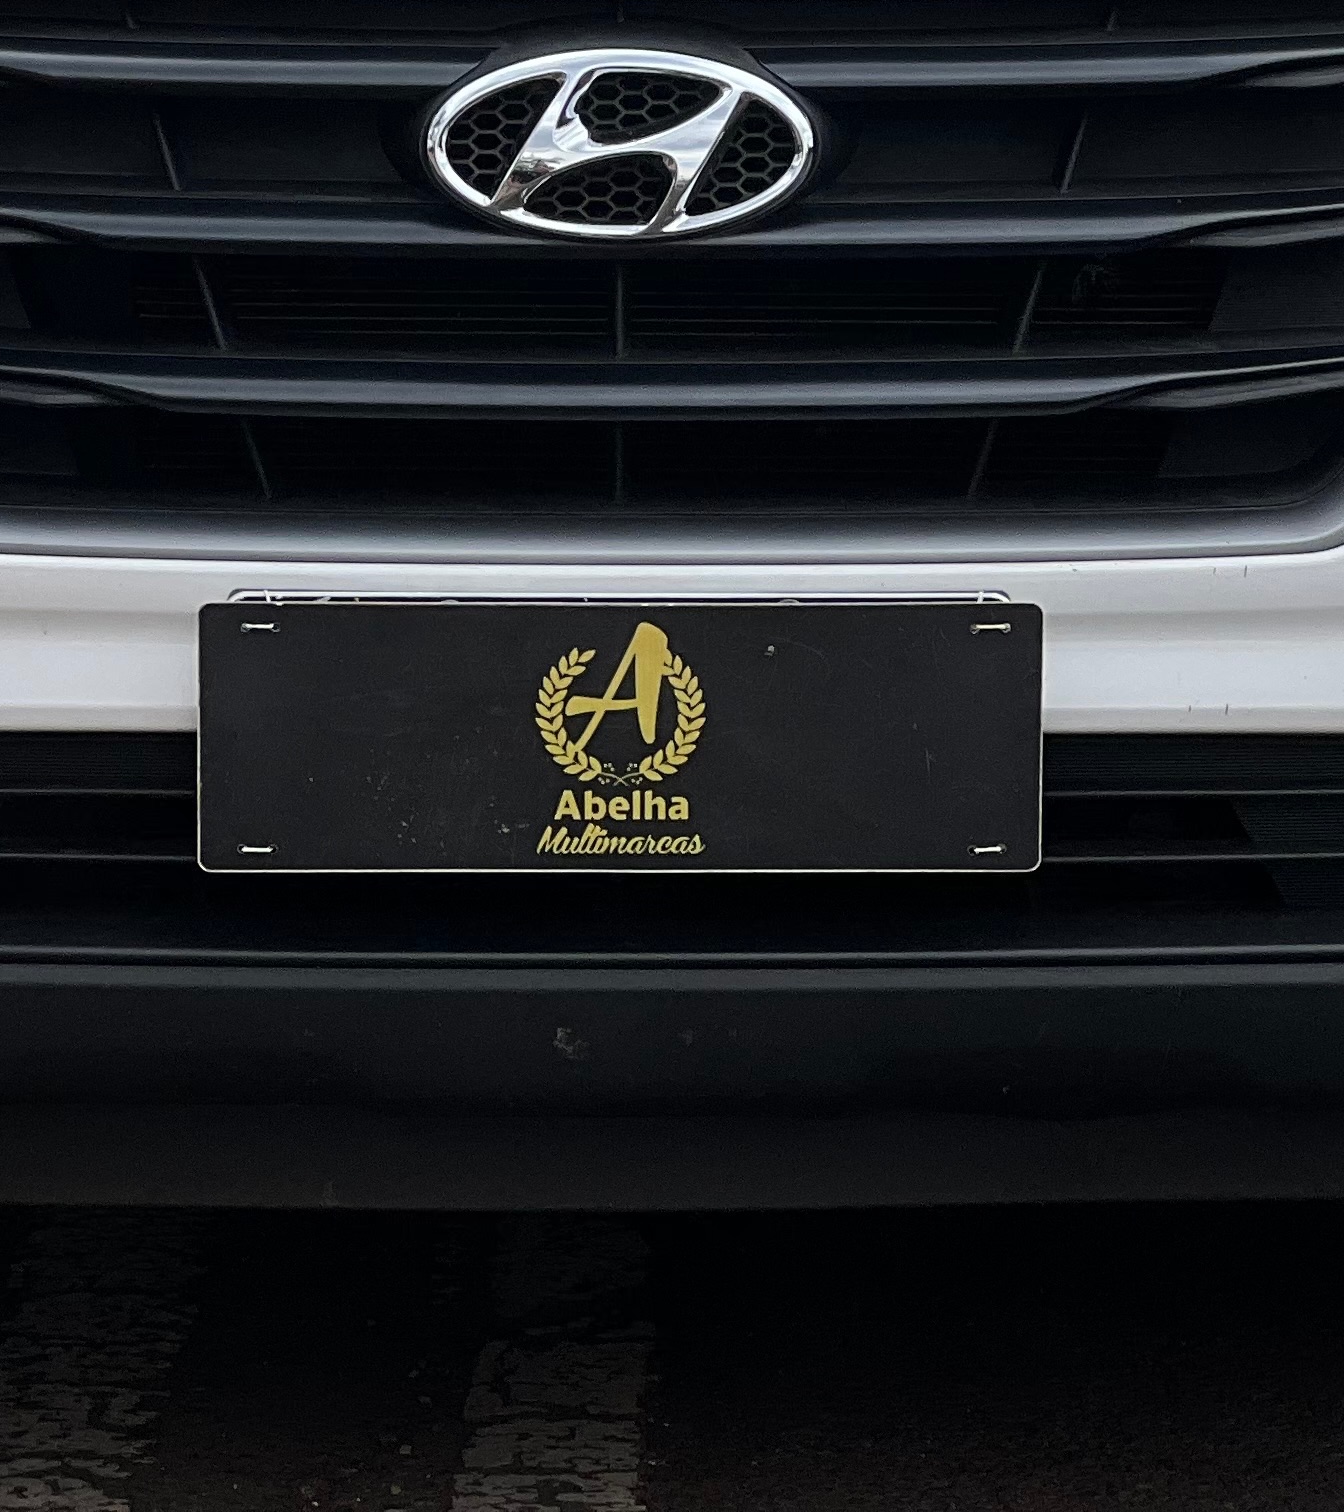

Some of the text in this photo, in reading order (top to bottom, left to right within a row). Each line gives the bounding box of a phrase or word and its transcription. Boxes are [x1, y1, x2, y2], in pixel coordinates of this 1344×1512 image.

[565, 622, 668, 752] A
[554, 789, 689, 821] Abelha
[536, 823, 706, 855] Multimarcas
